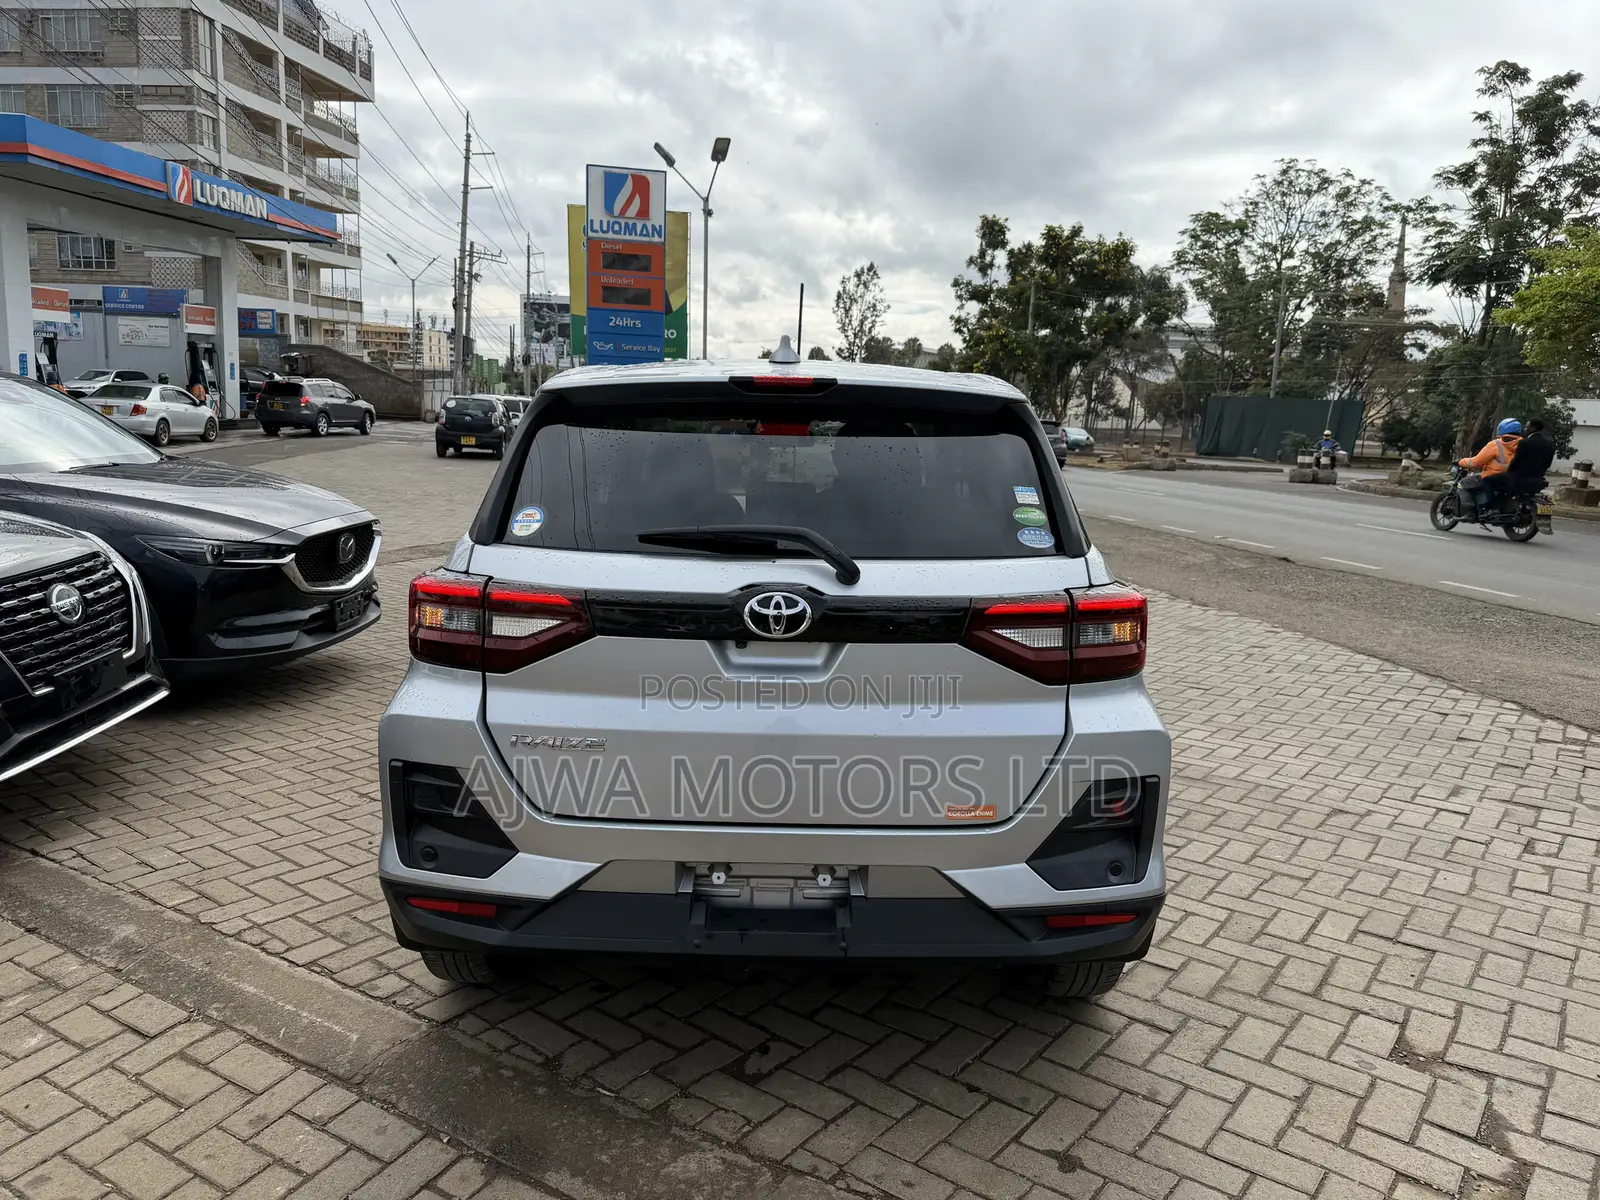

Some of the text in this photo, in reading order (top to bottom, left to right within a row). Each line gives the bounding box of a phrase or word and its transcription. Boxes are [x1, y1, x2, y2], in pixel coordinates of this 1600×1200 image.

[193, 178, 268, 219] LUQMAN
[589, 218, 663, 238] LUQMAN
[601, 242, 623, 251] Diesel
[601, 276, 634, 285] Unleaded
[608, 316, 642, 328] 24Hrs
[621, 343, 661, 353] Service Bay
[509, 733, 608, 752] RAIZE
